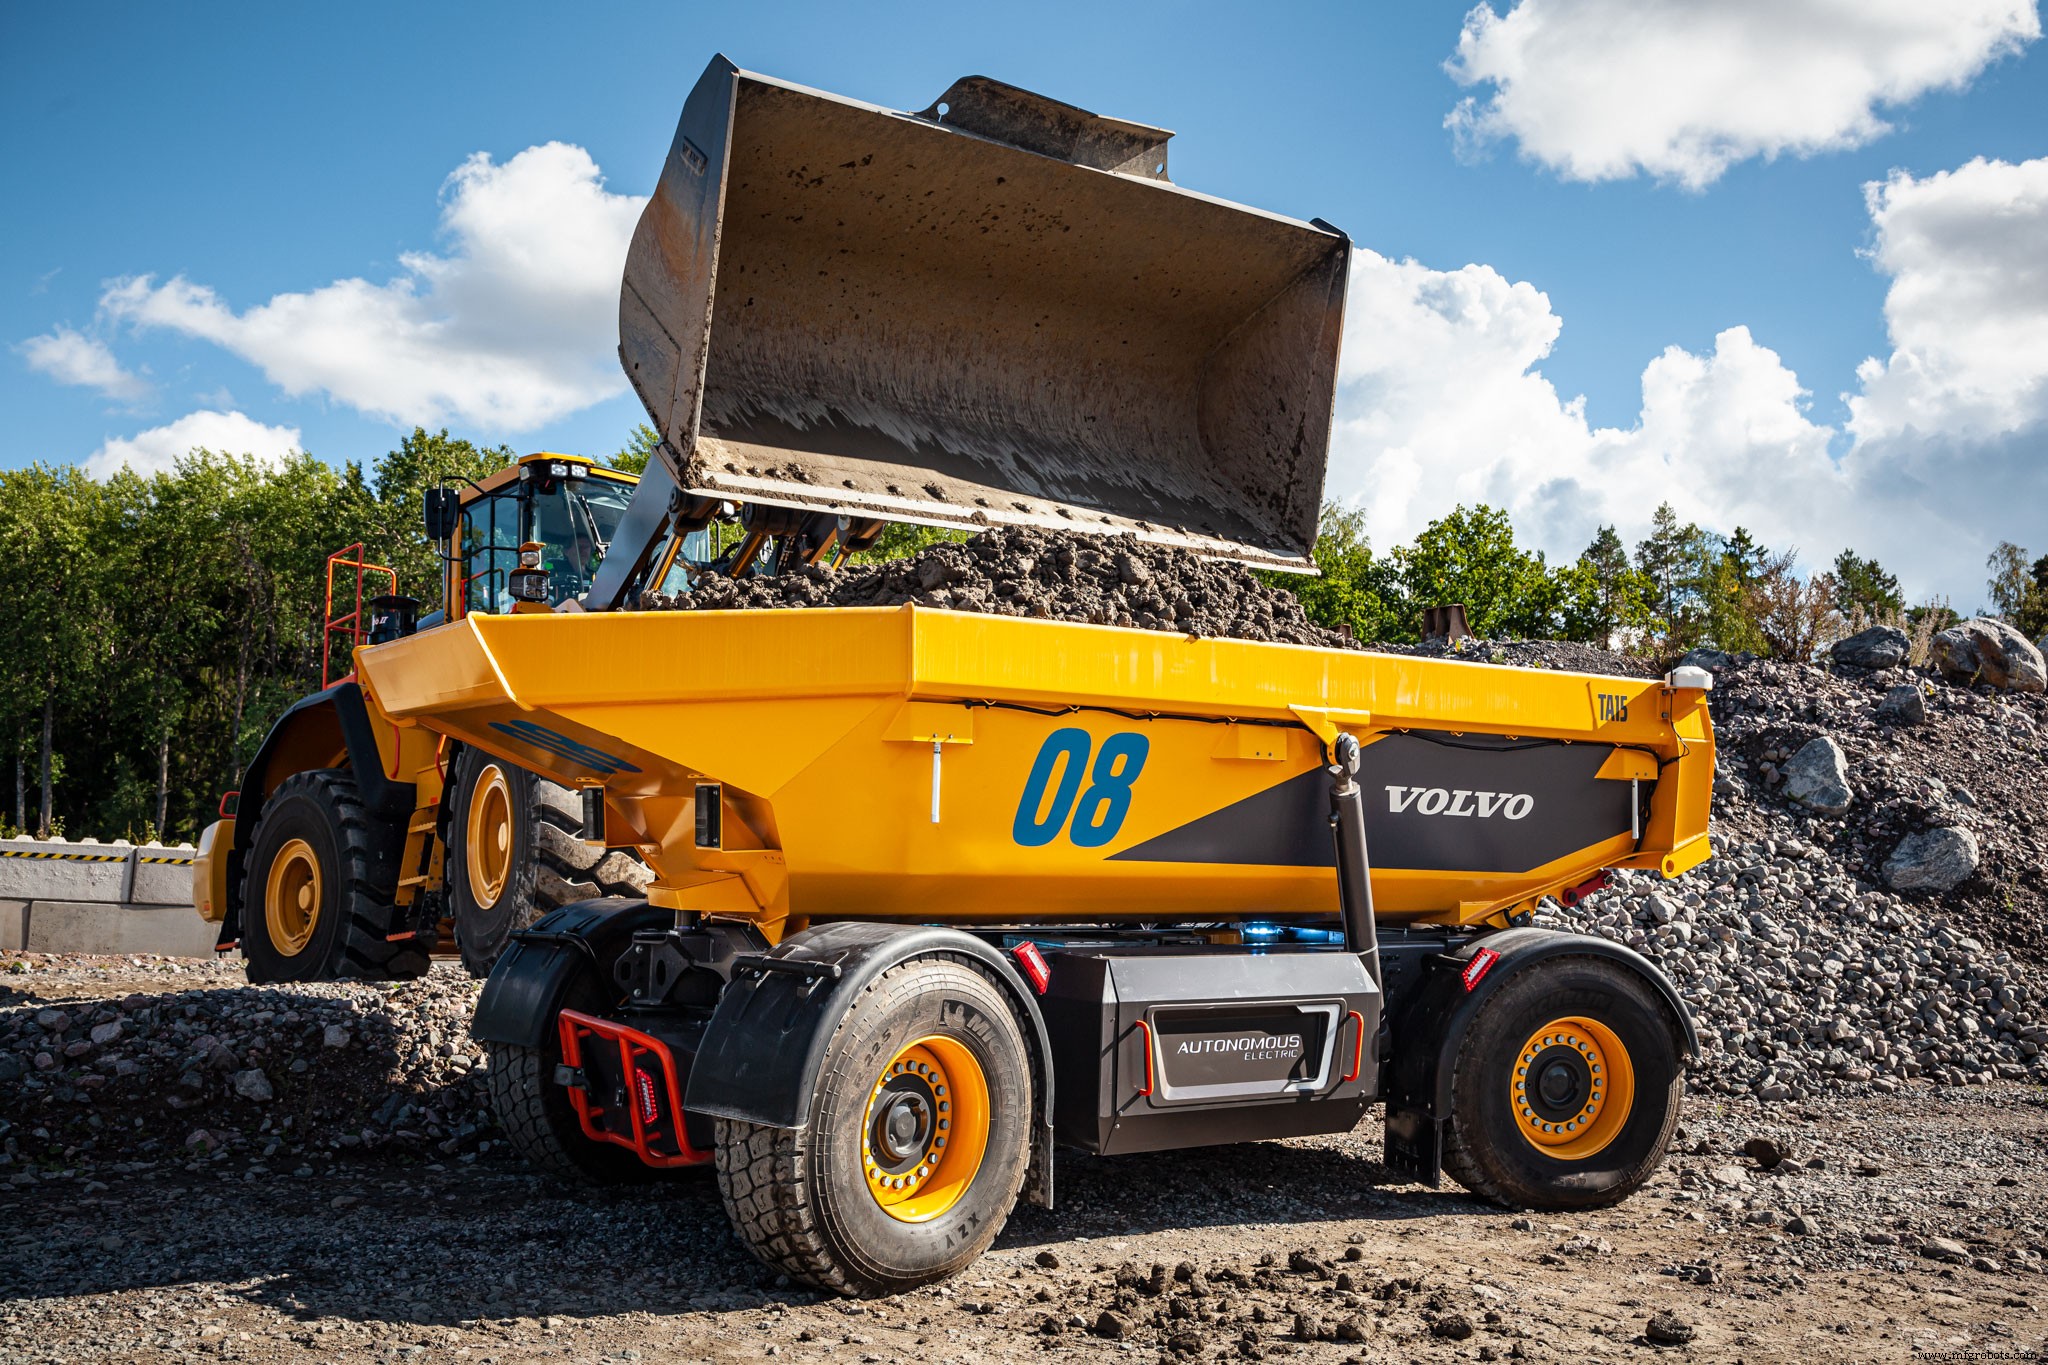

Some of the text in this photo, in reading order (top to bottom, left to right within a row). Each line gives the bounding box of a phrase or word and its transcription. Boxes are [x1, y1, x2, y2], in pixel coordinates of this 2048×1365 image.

[1598, 694, 1627, 722] TA15
[1012, 727, 1150, 847] 08
[1385, 785, 1534, 820] VOLVO
[864, 1028, 892, 1068] 22.5
[1177, 1036, 1300, 1054] AUTONOMOUS
[1244, 1050, 1298, 1061] ELECTRIC
